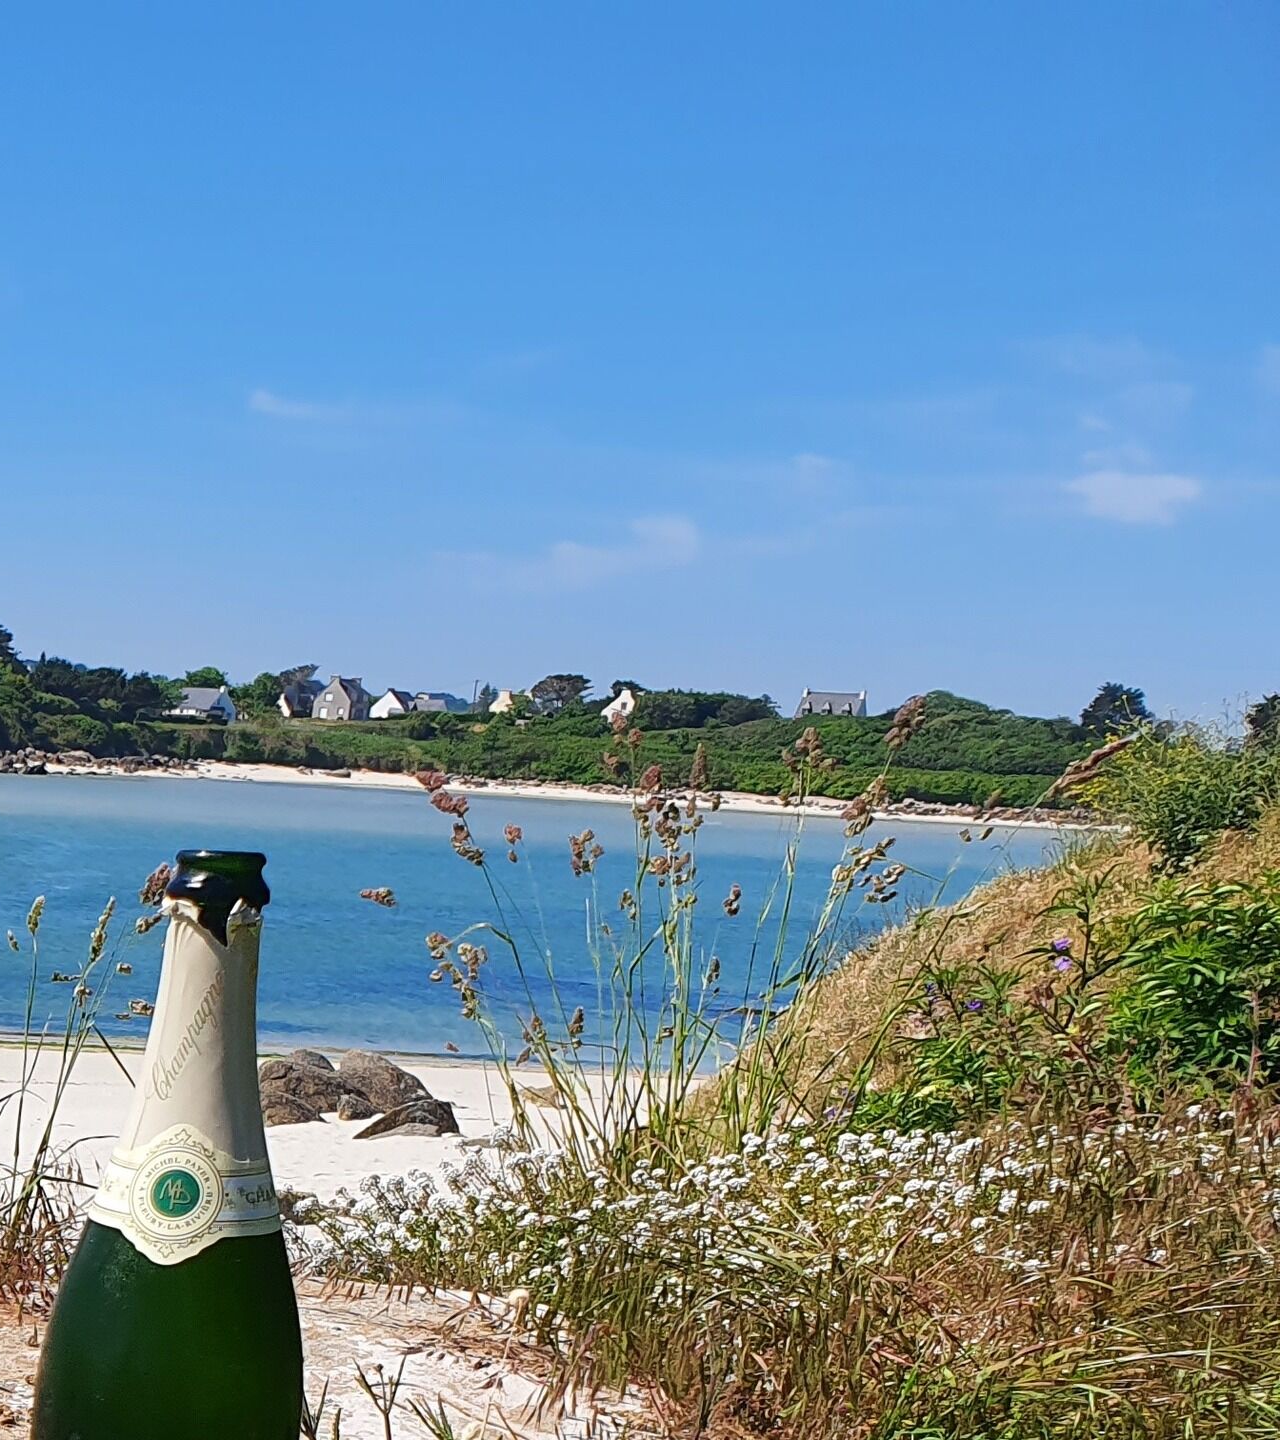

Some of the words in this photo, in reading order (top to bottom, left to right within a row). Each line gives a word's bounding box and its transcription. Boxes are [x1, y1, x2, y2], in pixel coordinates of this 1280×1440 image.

[144, 969, 225, 1101] Champagne
[144, 1157, 181, 1179] MICHEL
[185, 1158, 211, 1186] PAYER
